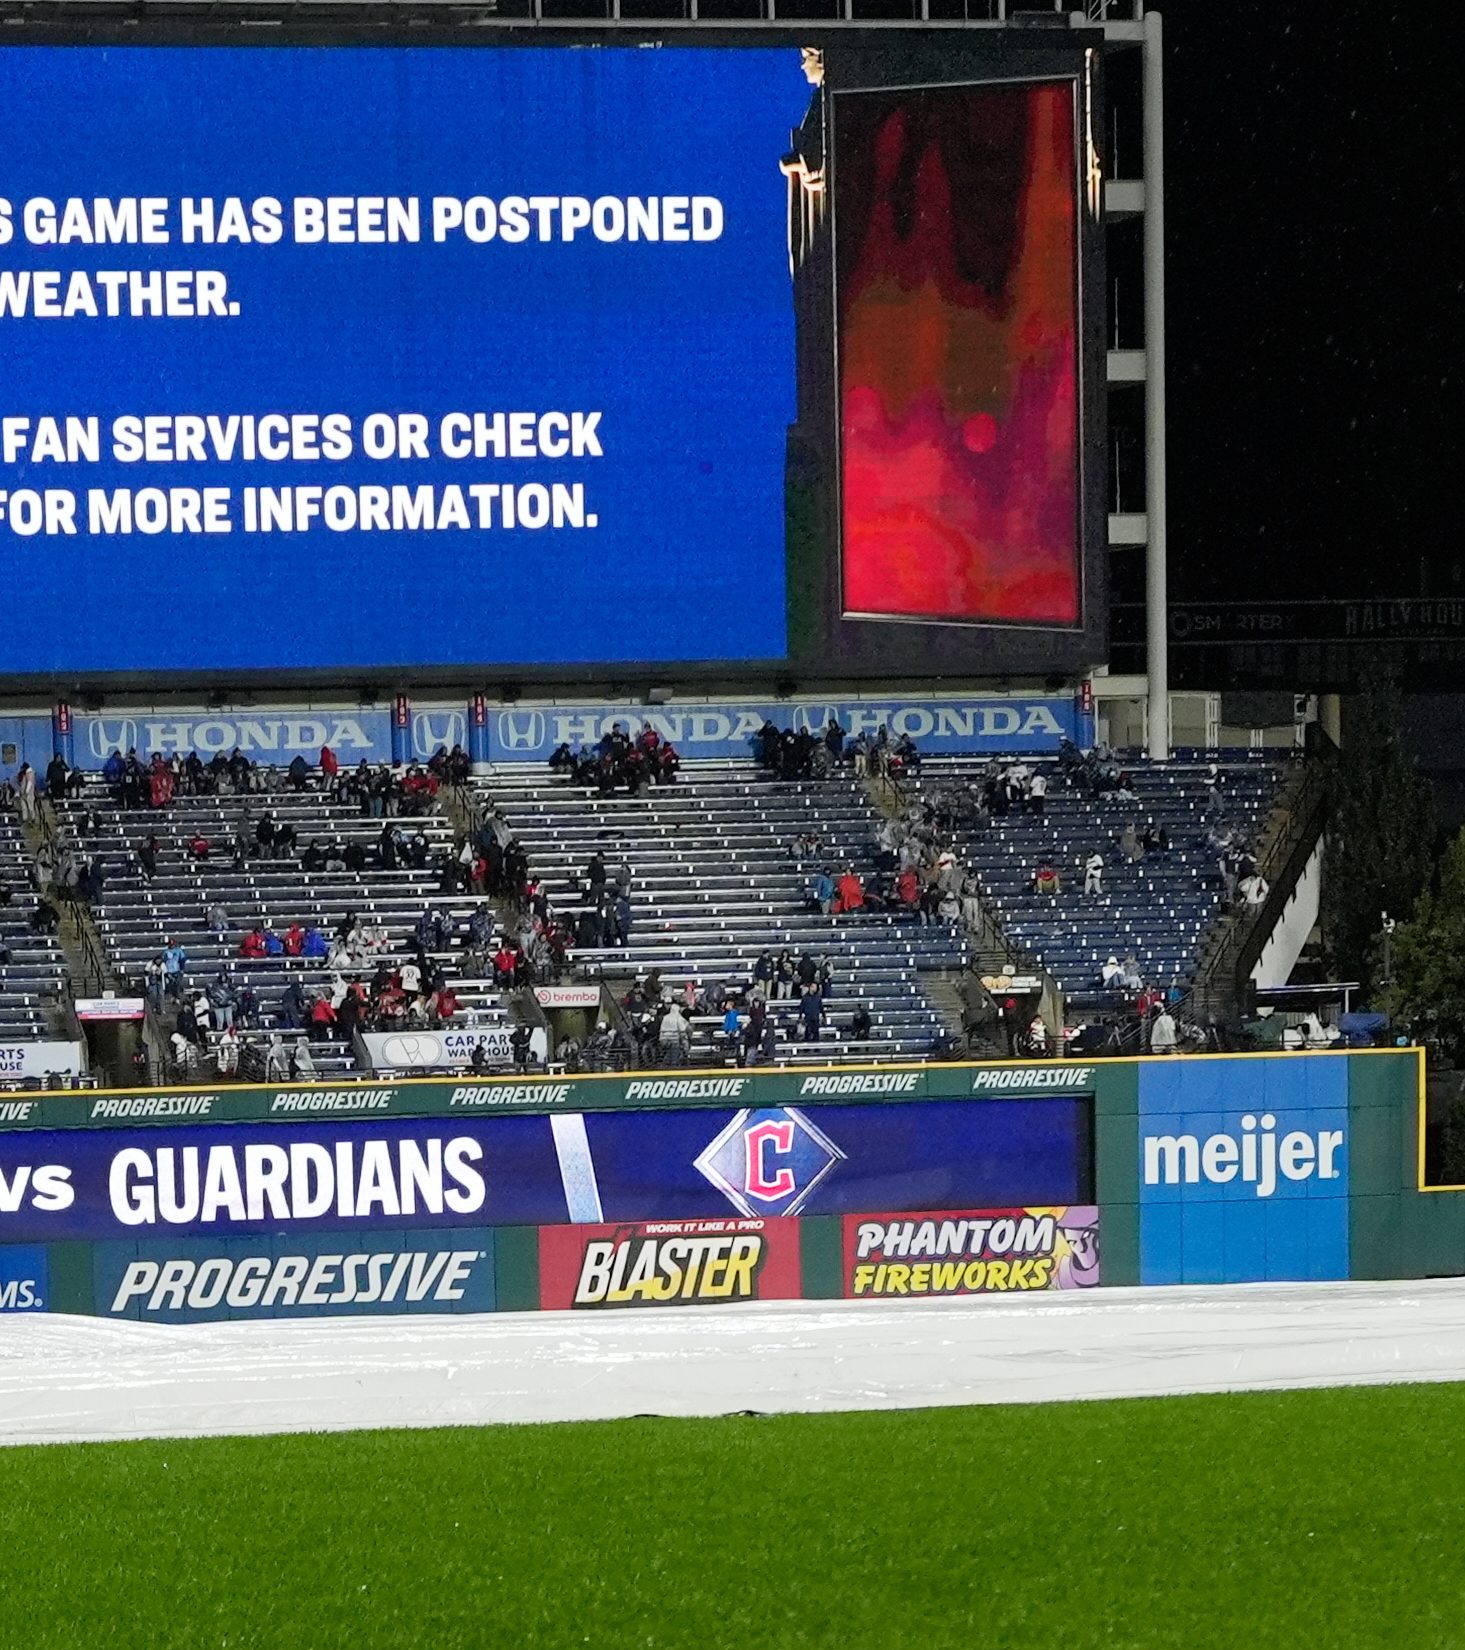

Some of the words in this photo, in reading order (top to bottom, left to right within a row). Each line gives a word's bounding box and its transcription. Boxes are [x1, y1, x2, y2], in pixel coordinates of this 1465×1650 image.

[24, 197, 170, 244] GAME
[182, 197, 282, 244] HAS
[293, 196, 425, 243] BEEN
[433, 195, 725, 242] POSTPONED
[3, 416, 100, 463] FAN
[112, 414, 353, 462] SERVICES
[363, 413, 429, 460] OR
[439, 412, 604, 458] CHECK
[87, 487, 231, 535] MORE
[244, 484, 598, 533] INFORMATION.
[145, 719, 373, 751] HONDA
[553, 711, 764, 744] HONDA
[847, 706, 1065, 738] HONDA
[553, 991, 597, 1002] brembo
[445, 1036, 475, 1047] CAR
[479, 1034, 512, 1045] PAR
[450, 1084, 571, 1106] PROGRESSIVE
[625, 1079, 745, 1100] PROGRESSIVE
[800, 1073, 919, 1095] PROGRESSIVE
[973, 1068, 1091, 1090] PROGRESSIVE
[90, 1096, 215, 1118] PROGRESSIVE
[271, 1090, 393, 1112] PROGRESSIVE
[744, 1119, 796, 1202] C
[1144, 1113, 1344, 1196] meijer
[109, 1136, 486, 1226] GUARDIANS
[645, 1223, 681, 1234] WORK
[684, 1223, 696, 1233] IT
[697, 1222, 725, 1232] LIKE
[725, 1221, 737, 1231] A
[738, 1220, 765, 1230] PRO
[856, 1217, 1055, 1258] PHANTOM
[110, 1250, 482, 1312] PROGRESSIVE
[575, 1234, 763, 1304] BLASTER
[854, 1258, 1053, 1295] FIREWORKS
